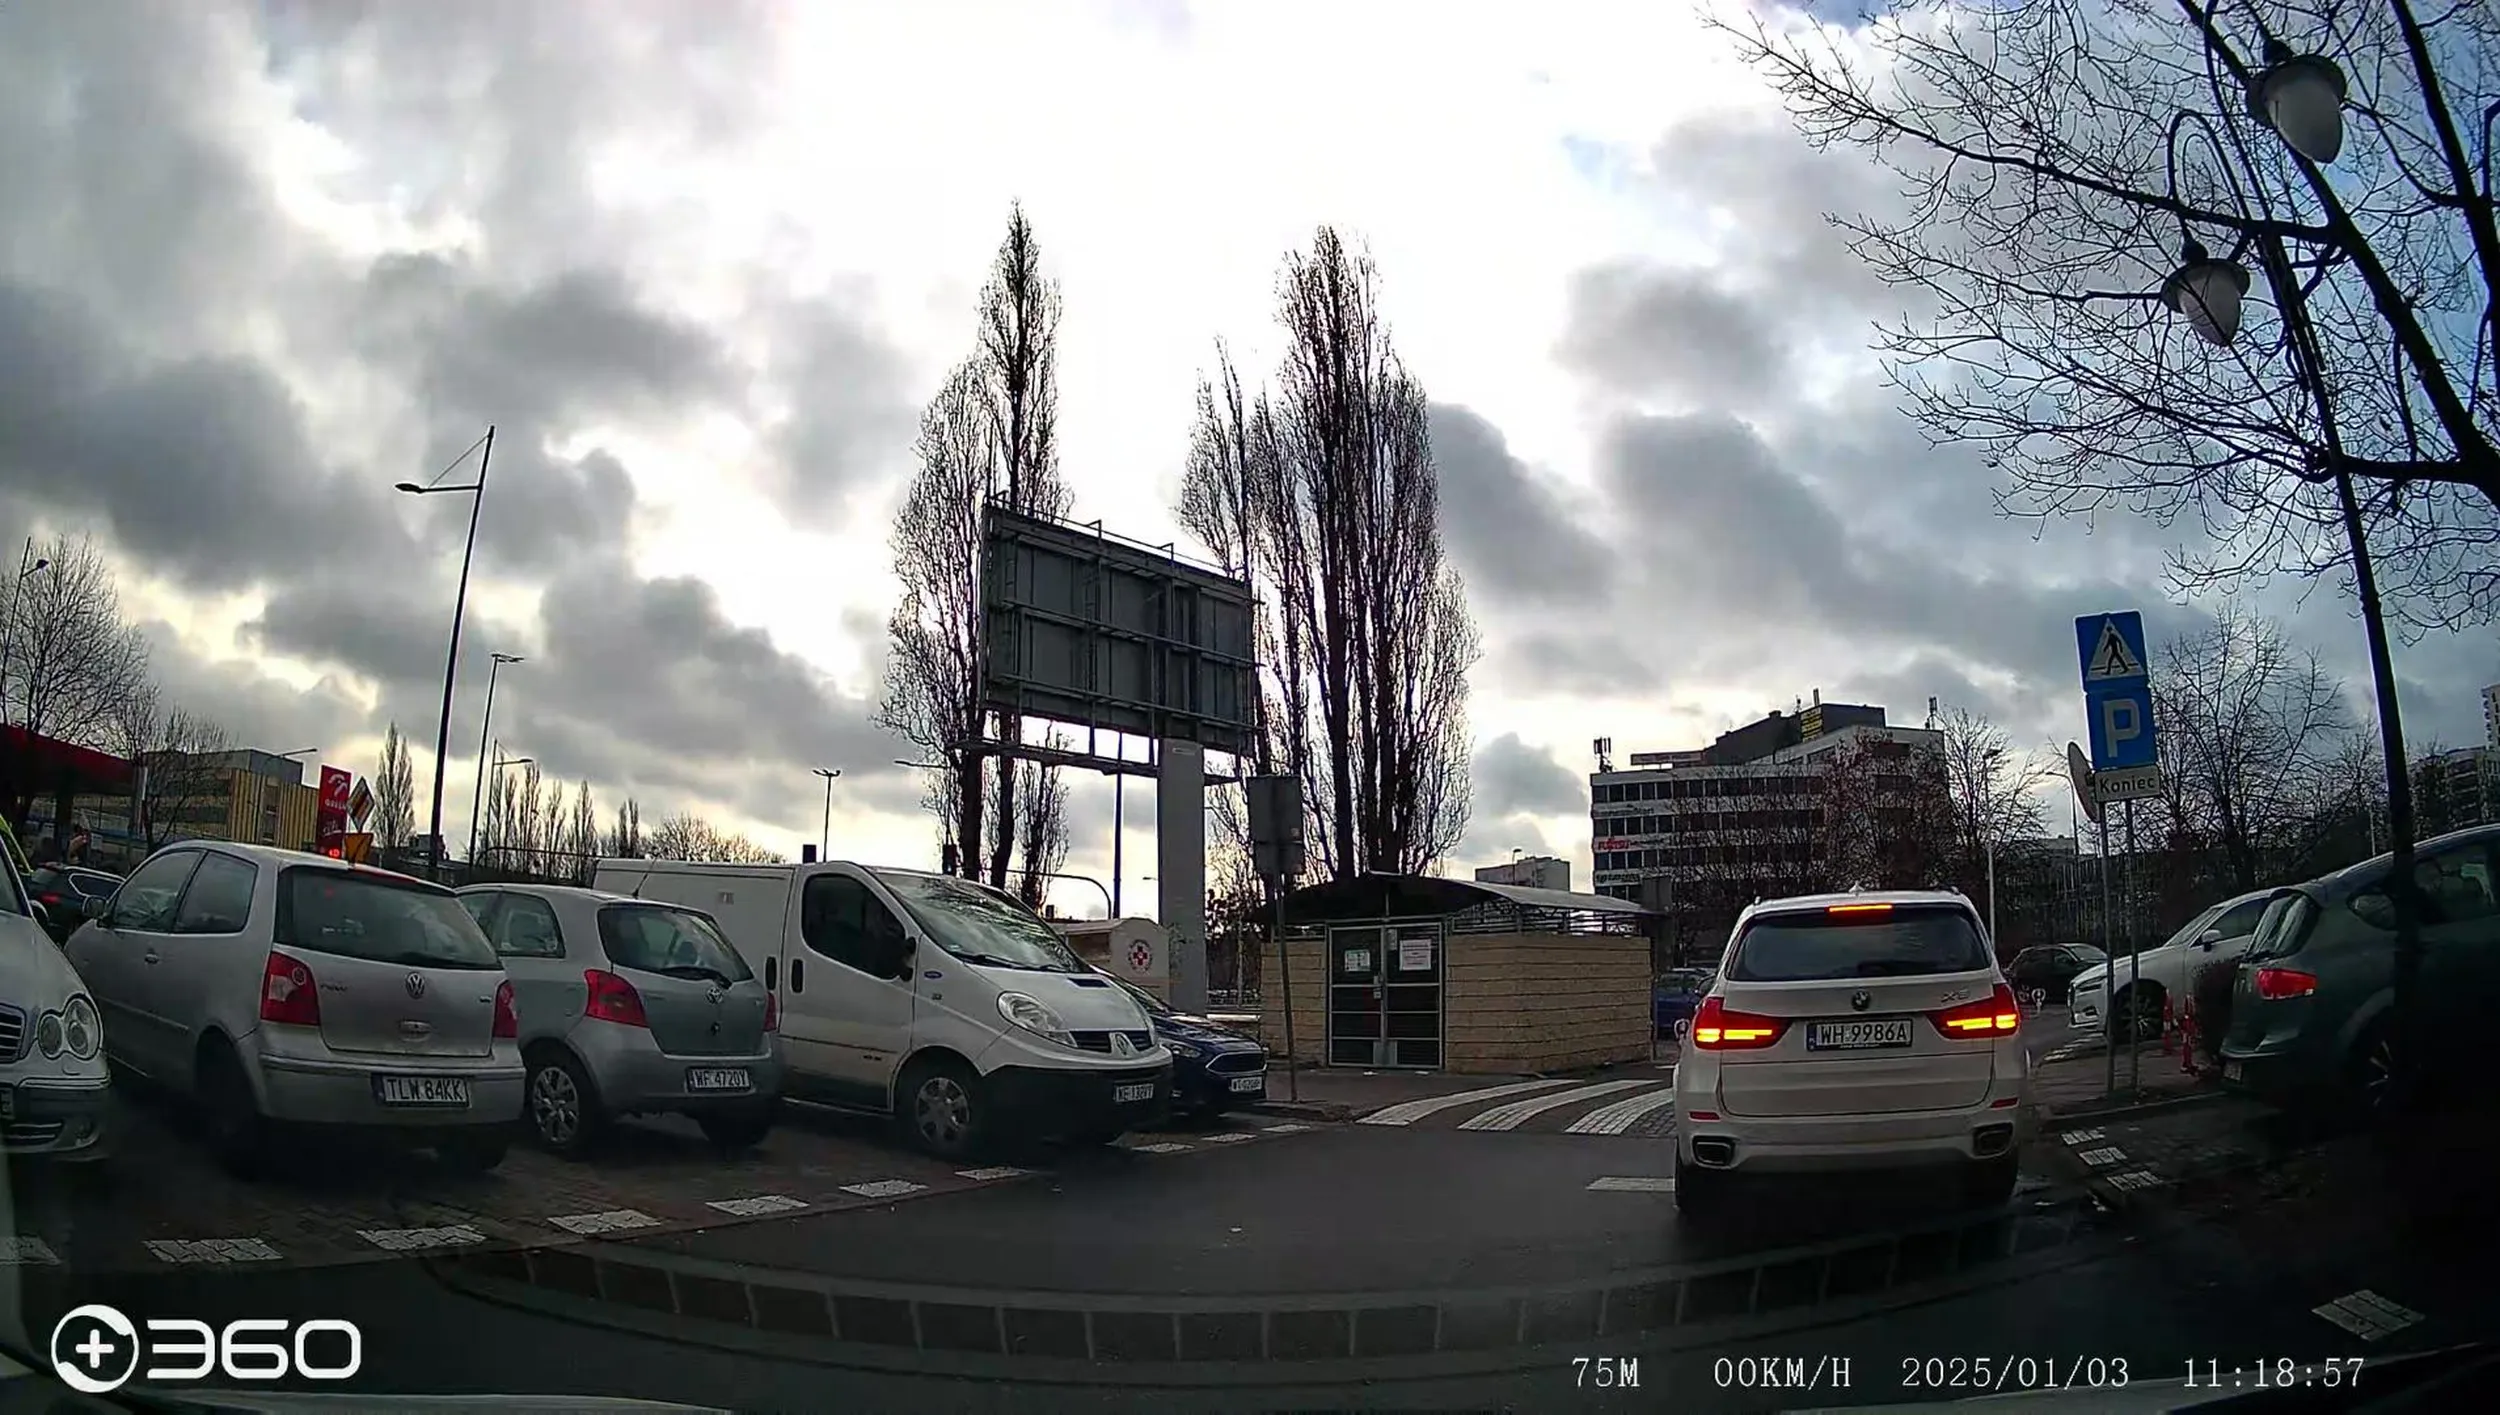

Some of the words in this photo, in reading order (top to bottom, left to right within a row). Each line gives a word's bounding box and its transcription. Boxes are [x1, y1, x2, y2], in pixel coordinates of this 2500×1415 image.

[2103, 698, 2141, 758] P
[2099, 775, 2155, 795] Koniec
[1820, 1025, 1845, 1044] WH
[1851, 1022, 1908, 1043] 9986A
[424, 1079, 463, 1101] 84KK
